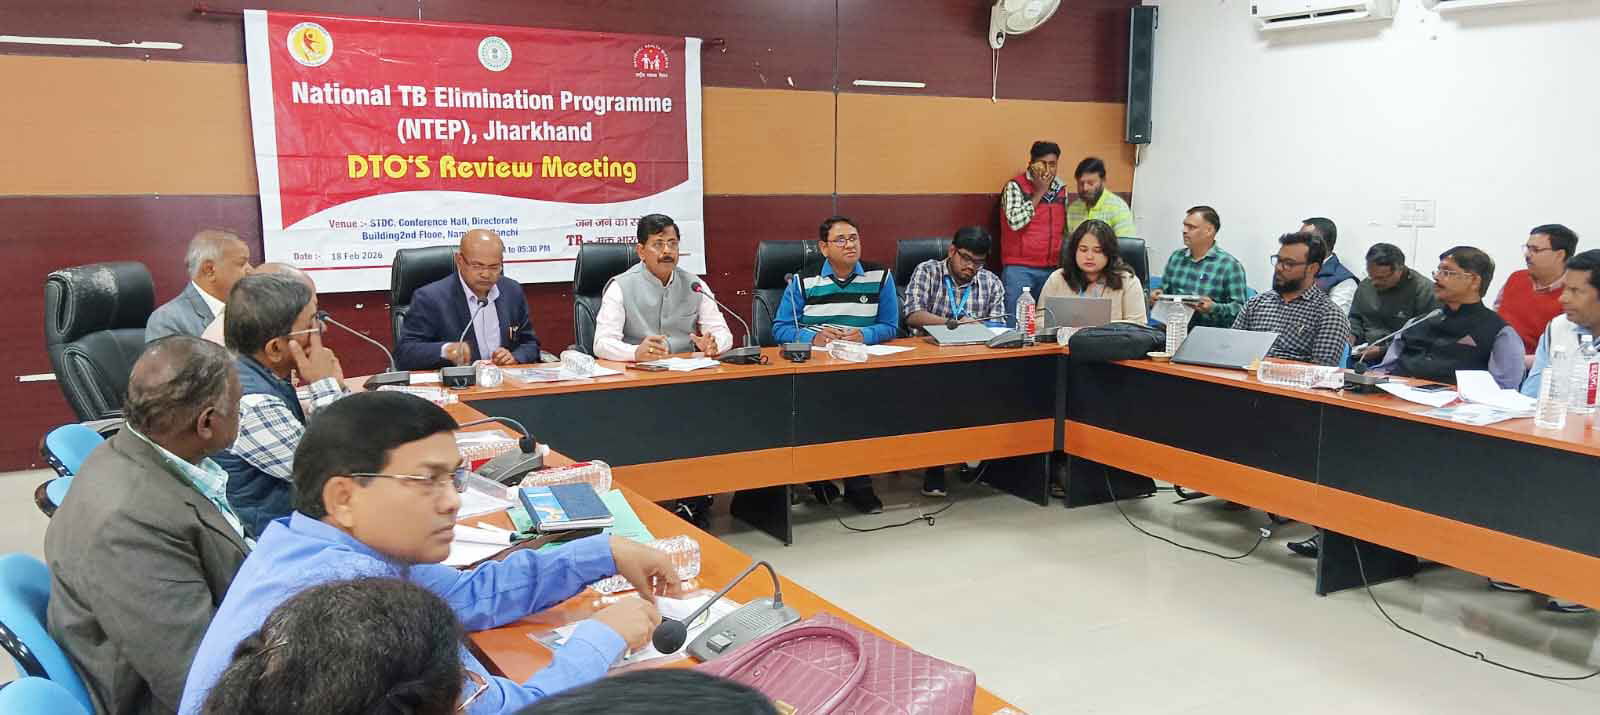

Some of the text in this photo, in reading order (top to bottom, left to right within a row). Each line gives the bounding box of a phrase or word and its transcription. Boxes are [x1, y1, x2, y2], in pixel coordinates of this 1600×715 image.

[291, 81, 673, 116] National TB Elimination Programme
[397, 118, 593, 144] (NTEP), Jharkhand
[347, 154, 637, 183] DTO'S Review Meeting
[329, 219, 358, 228] Venue
[370, 219, 396, 228] STDC,
[398, 218, 448, 227] Conference
[450, 217, 469, 226] Hall,
[471, 216, 518, 226] Directorate
[362, 231, 417, 241] Building2nd
[517, 245, 537, 253] 05:30
[539, 244, 551, 252] PM
[293, 251, 313, 261] Date
[344, 251, 360, 260] Feb
[361, 250, 384, 260] 2026
